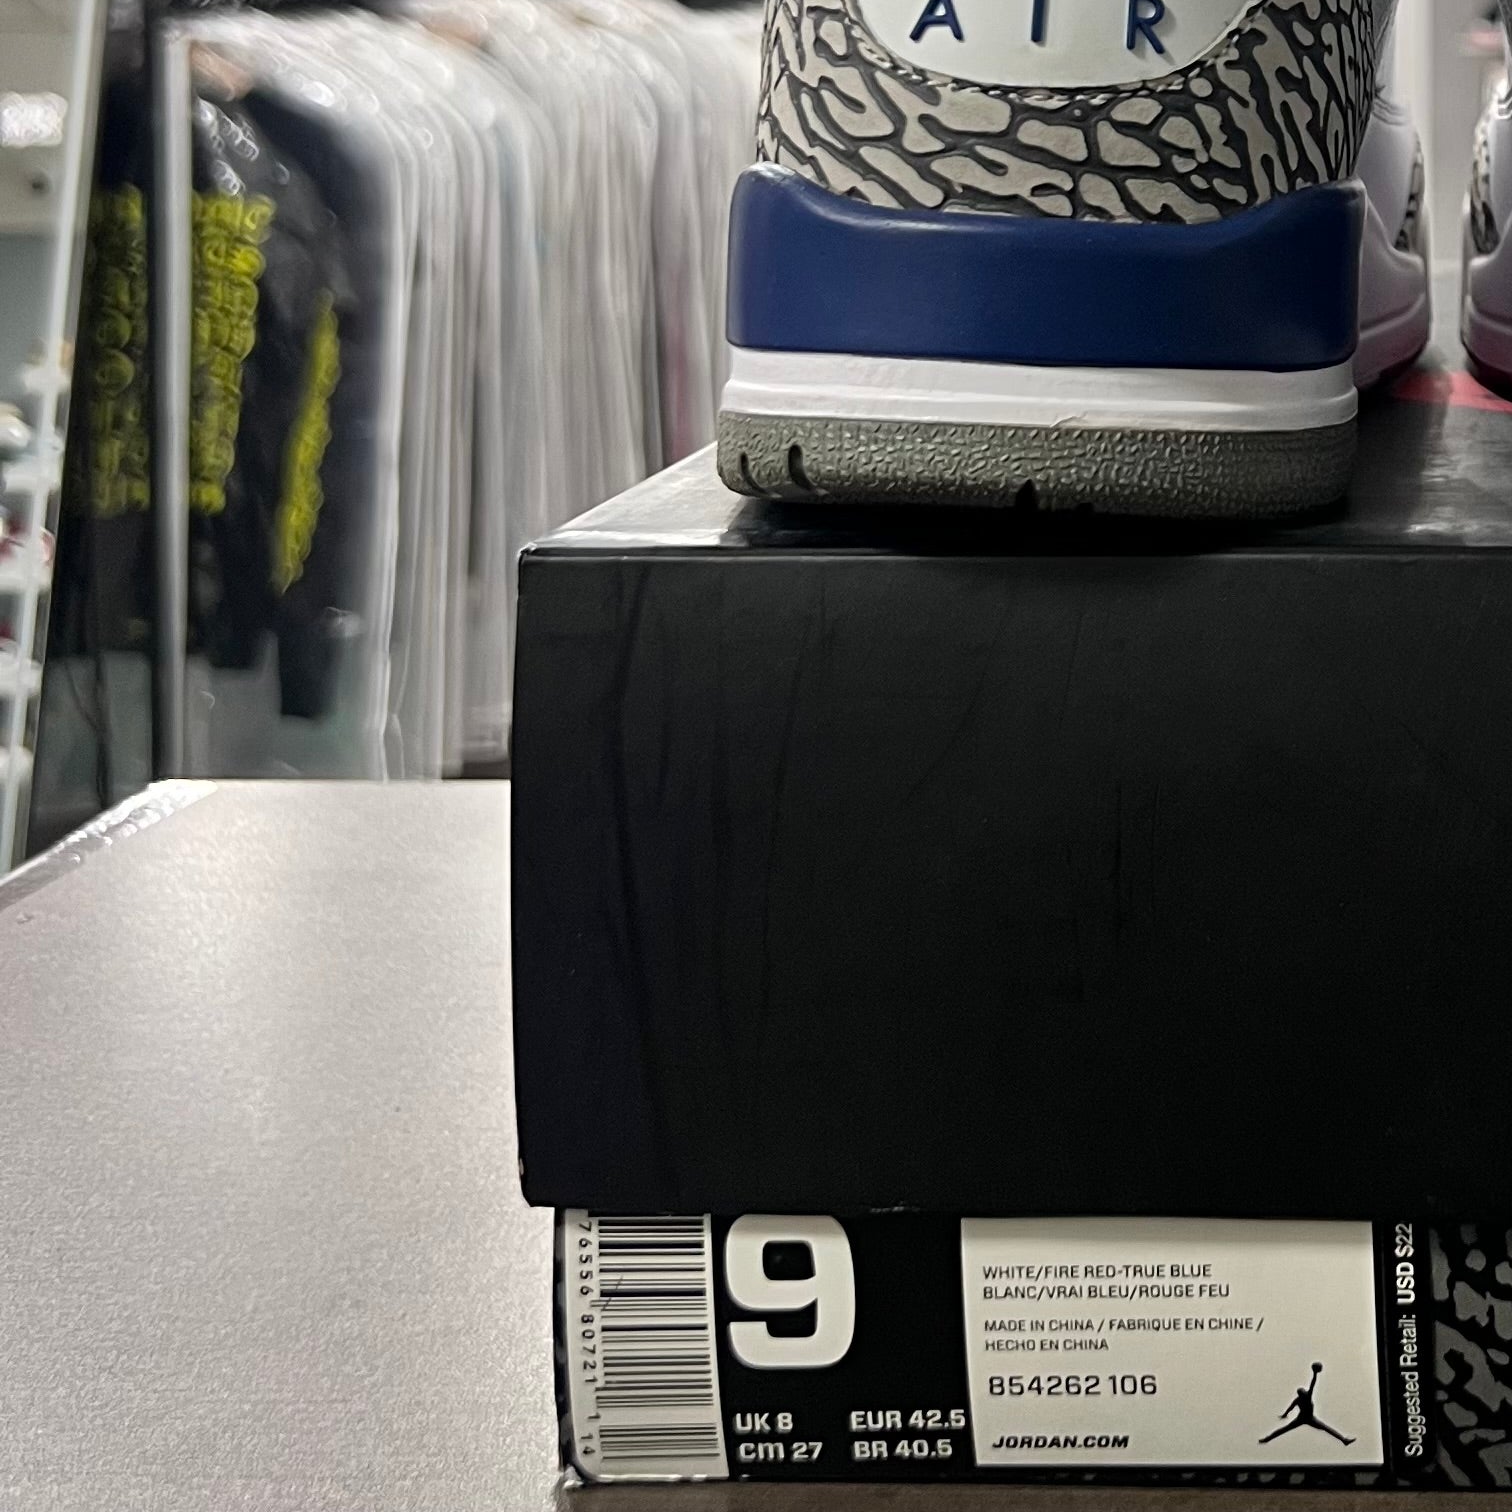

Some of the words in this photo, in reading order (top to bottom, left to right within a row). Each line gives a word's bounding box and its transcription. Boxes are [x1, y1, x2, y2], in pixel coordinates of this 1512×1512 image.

[983, 1265, 1080, 1281] WHITE/FIRE
[1084, 1264, 1166, 1279] RED-TRUE
[1170, 1263, 1212, 1278] BLUE
[725, 1214, 855, 1370] 9
[983, 1286, 1083, 1301] BLANC/VRAI
[1088, 1284, 1194, 1300] BLEU/ROUGE
[1199, 1283, 1230, 1298] FEU
[1396, 1261, 1416, 1305] USD
[984, 1319, 1026, 1332] MADE
[1031, 1319, 1045, 1331] IN
[1049, 1319, 1094, 1332] CHINA
[1109, 1318, 1181, 1332] FABRIQUE
[1185, 1318, 1204, 1330] EN
[1208, 1318, 1253, 1331] CHINE
[985, 1339, 1036, 1352] HECHO
[1040, 1339, 1060, 1351] EN
[1063, 1338, 1109, 1351] CHINA
[1399, 1314, 1418, 1366] Retail:
[735, 1412, 771, 1433] UK
[776, 1412, 794, 1433] 8
[850, 1410, 902, 1432] EUR
[908, 1409, 966, 1429] 42.5
[1401, 1371, 1425, 1457] Suggested
[791, 1442, 823, 1461] 27
[853, 1440, 888, 1461] BR
[894, 1438, 953, 1460] 40.5
[991, 1434, 1130, 1449] JORDAN.COM
